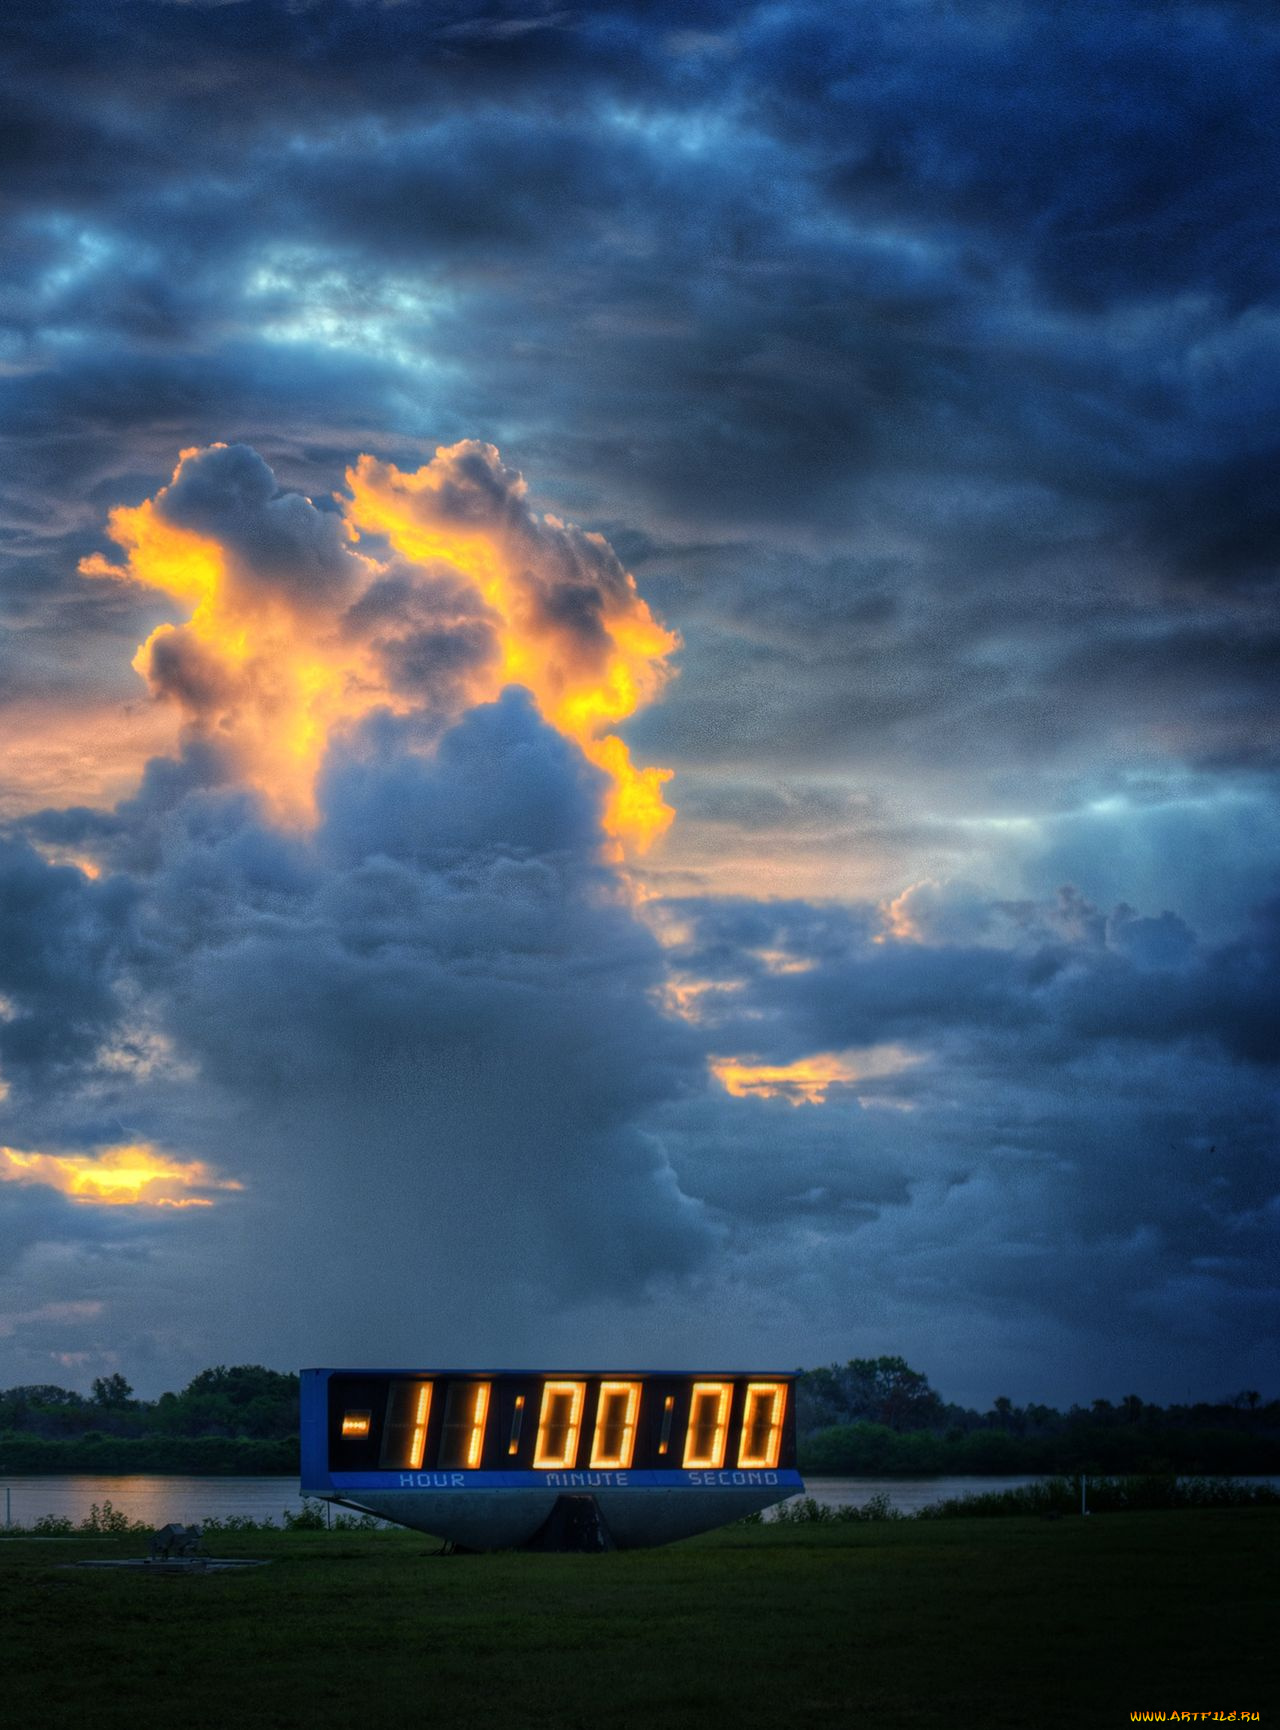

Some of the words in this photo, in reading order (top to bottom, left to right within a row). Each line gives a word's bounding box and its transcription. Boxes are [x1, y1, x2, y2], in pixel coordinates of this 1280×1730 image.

[399, 1473, 465, 1487] HOUR
[546, 1473, 629, 1487] MINUTE
[688, 1472, 779, 1486] SECOND
